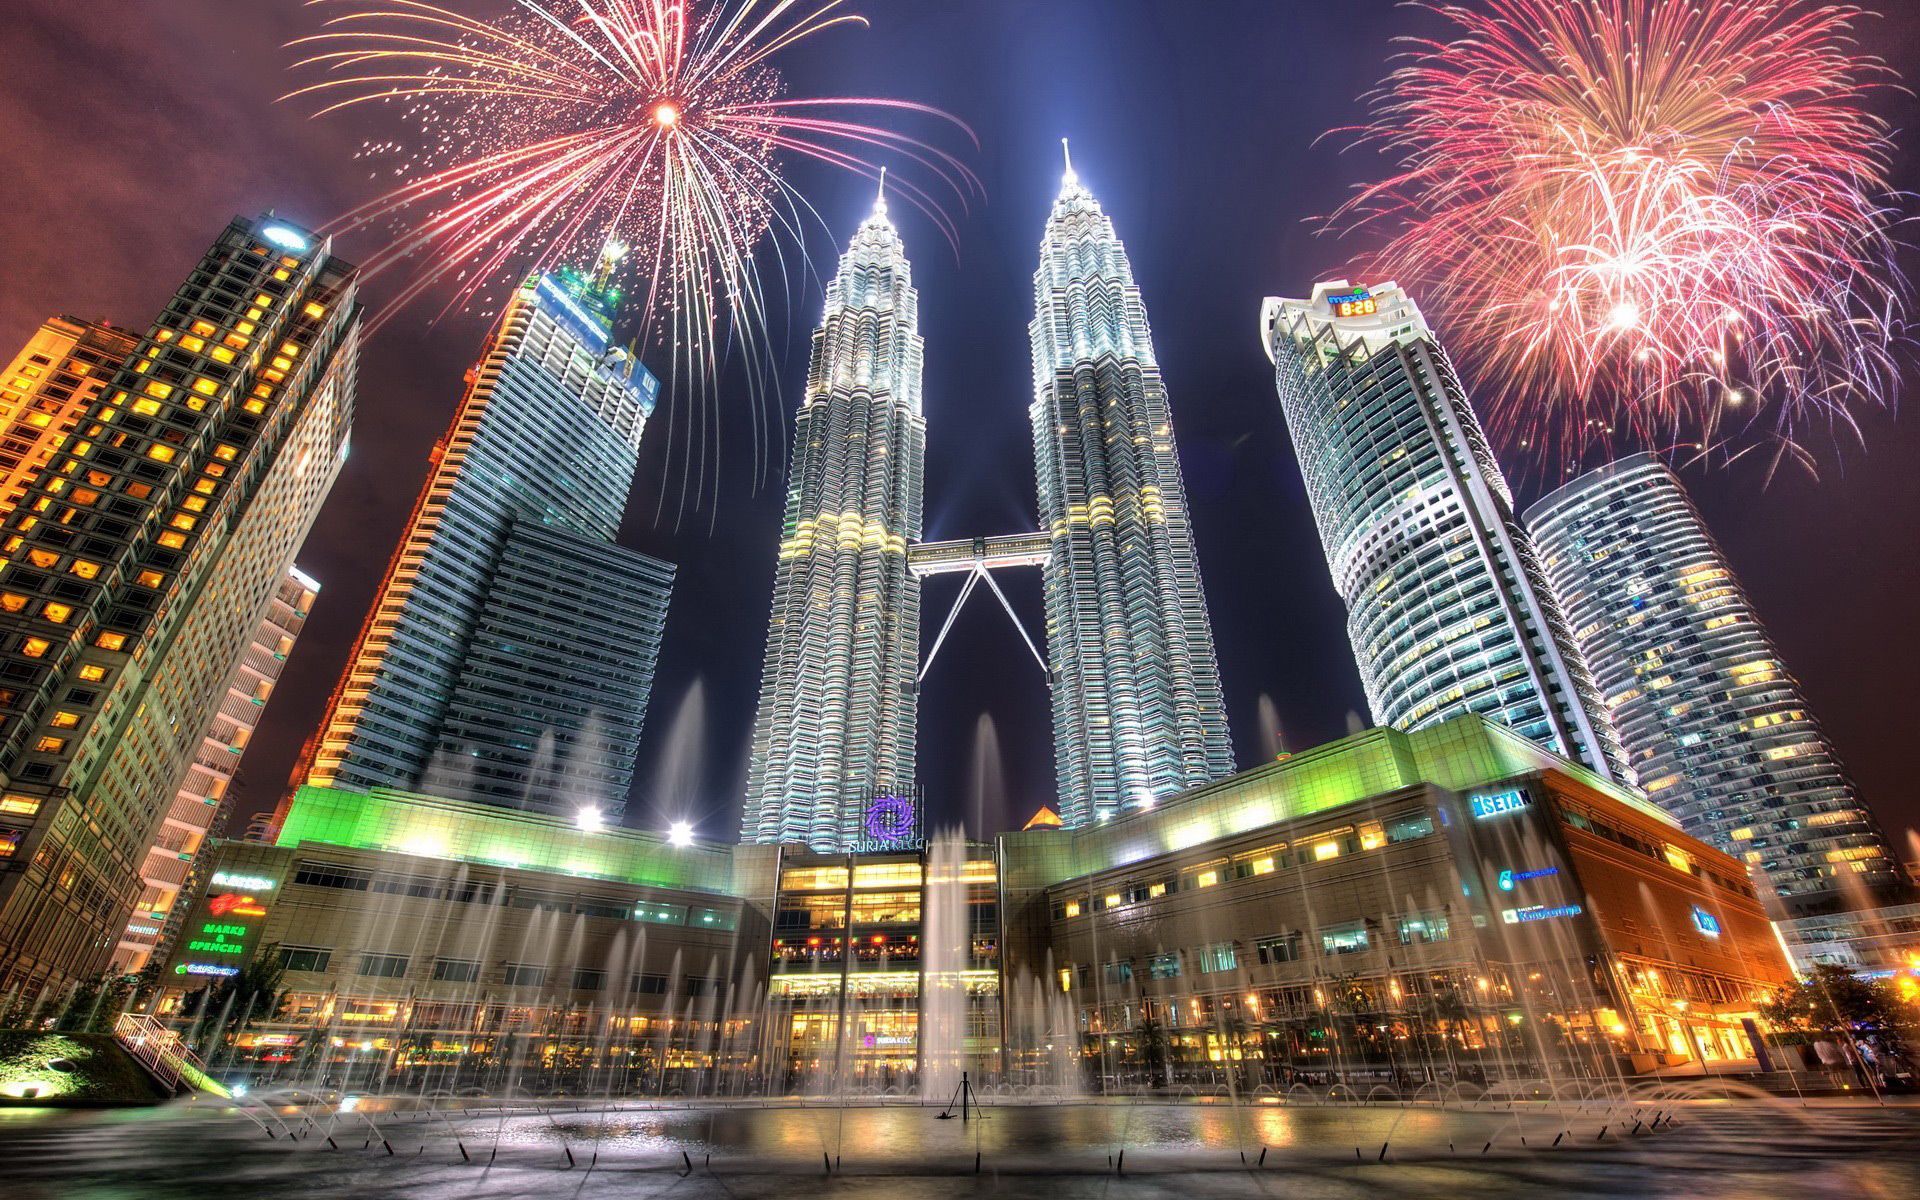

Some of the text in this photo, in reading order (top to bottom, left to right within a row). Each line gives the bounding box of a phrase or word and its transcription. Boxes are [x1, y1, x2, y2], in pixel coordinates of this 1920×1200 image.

[1328, 292, 1369, 304] maxis
[849, 838, 924, 853] SURIA KLCC
[203, 924, 246, 936] MARKS
[215, 934, 224, 943] &
[189, 941, 242, 954] SPENCER
